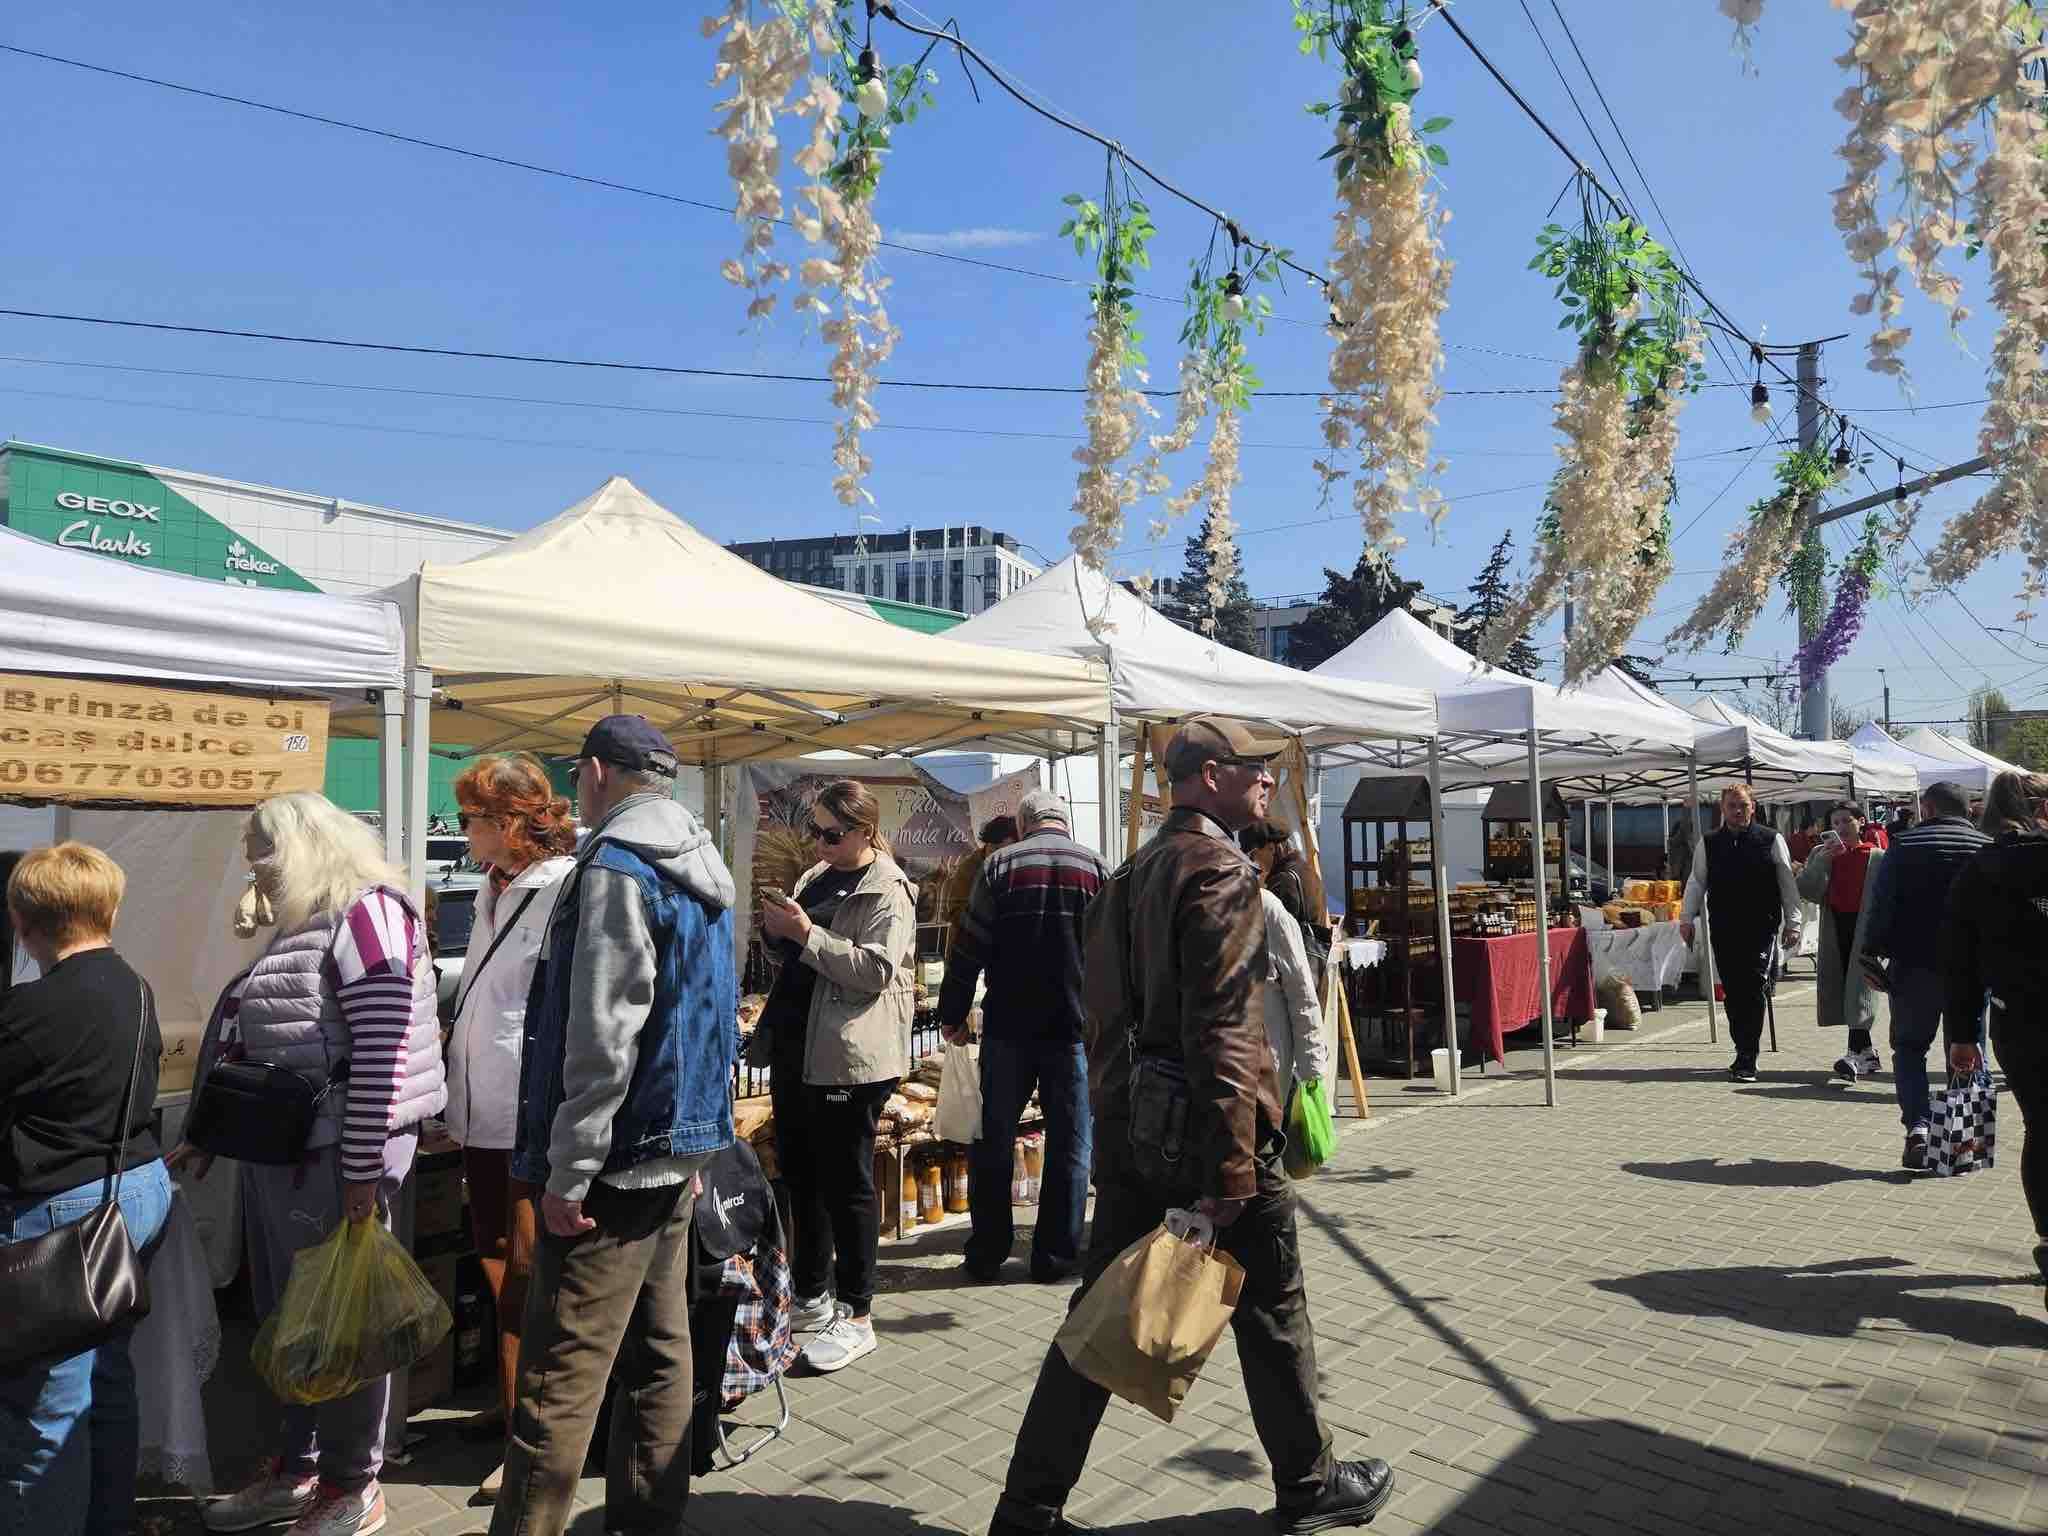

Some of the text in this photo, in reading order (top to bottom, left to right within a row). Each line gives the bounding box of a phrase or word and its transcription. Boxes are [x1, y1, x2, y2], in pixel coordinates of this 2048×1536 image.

[56, 492, 161, 522] GEOX
[58, 520, 152, 557] Clarks
[225, 554, 280, 575] rieker
[192, 703, 249, 727] de
[264, 709, 304, 730] oi
[117, 728, 255, 756] dulce
[0, 759, 283, 792] 067703057
